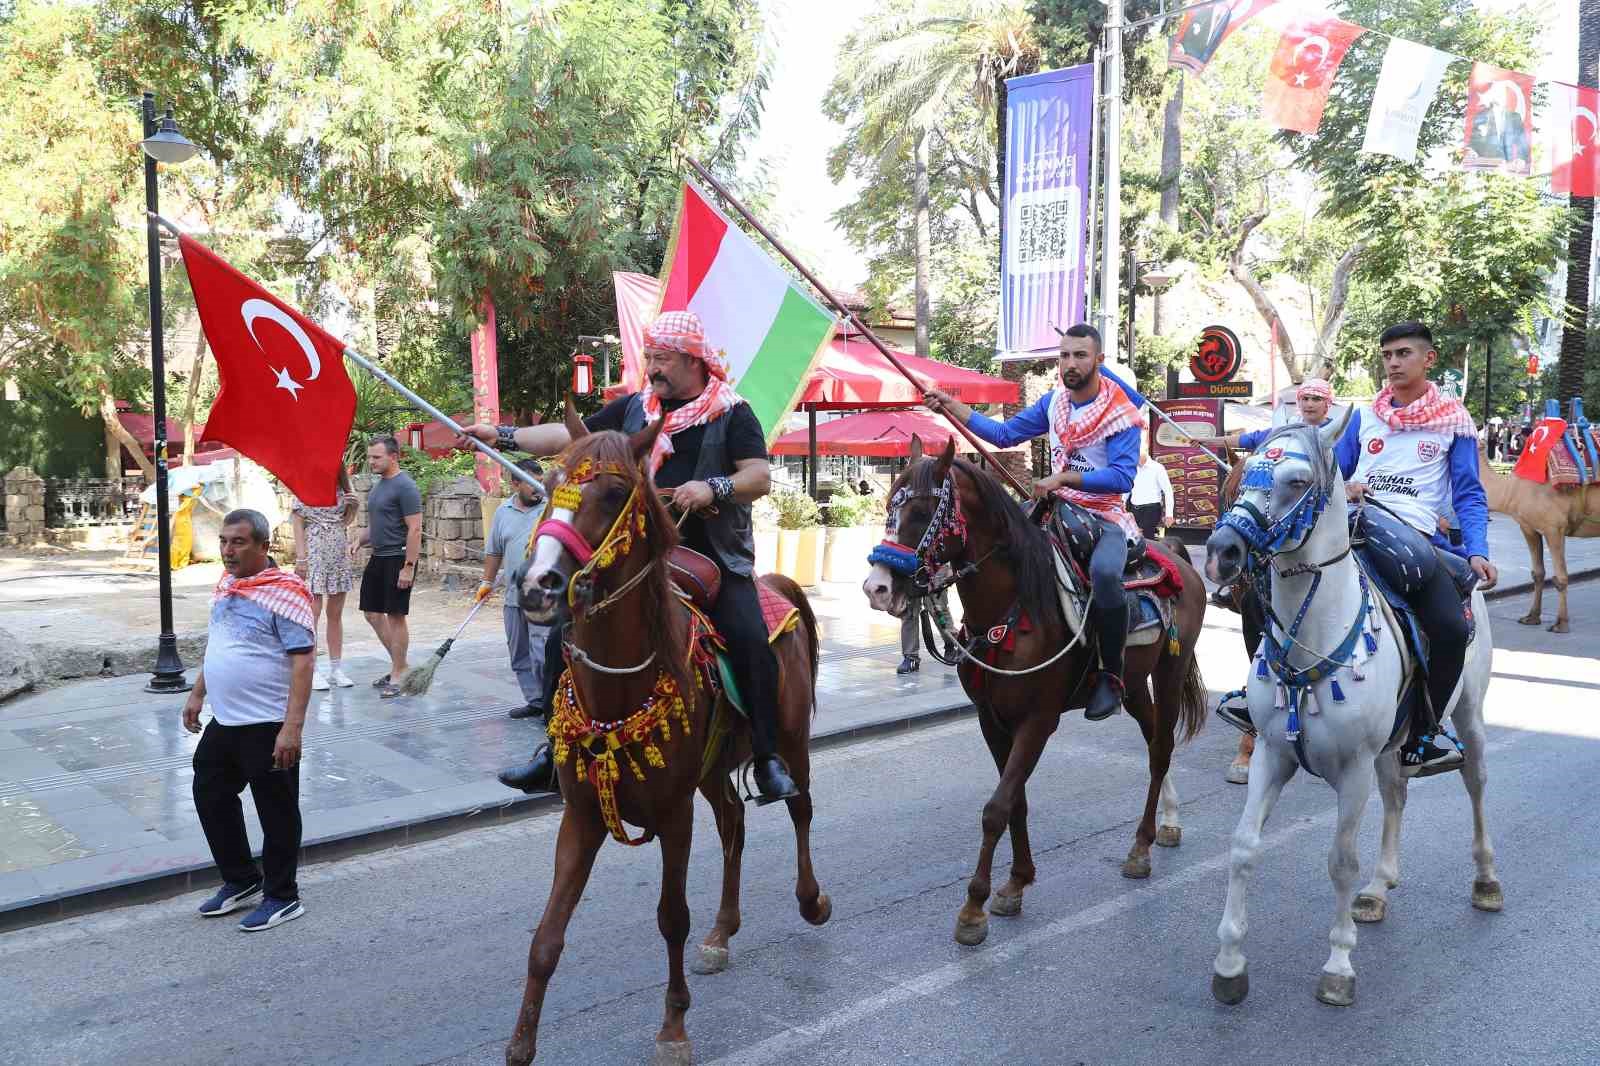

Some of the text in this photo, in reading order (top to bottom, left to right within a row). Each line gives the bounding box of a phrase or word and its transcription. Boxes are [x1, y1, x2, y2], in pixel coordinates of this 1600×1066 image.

[1055, 155, 1073, 169] ME
[1368, 473, 1414, 486] GÖKHAS
[1371, 484, 1419, 498] KURTARMA
